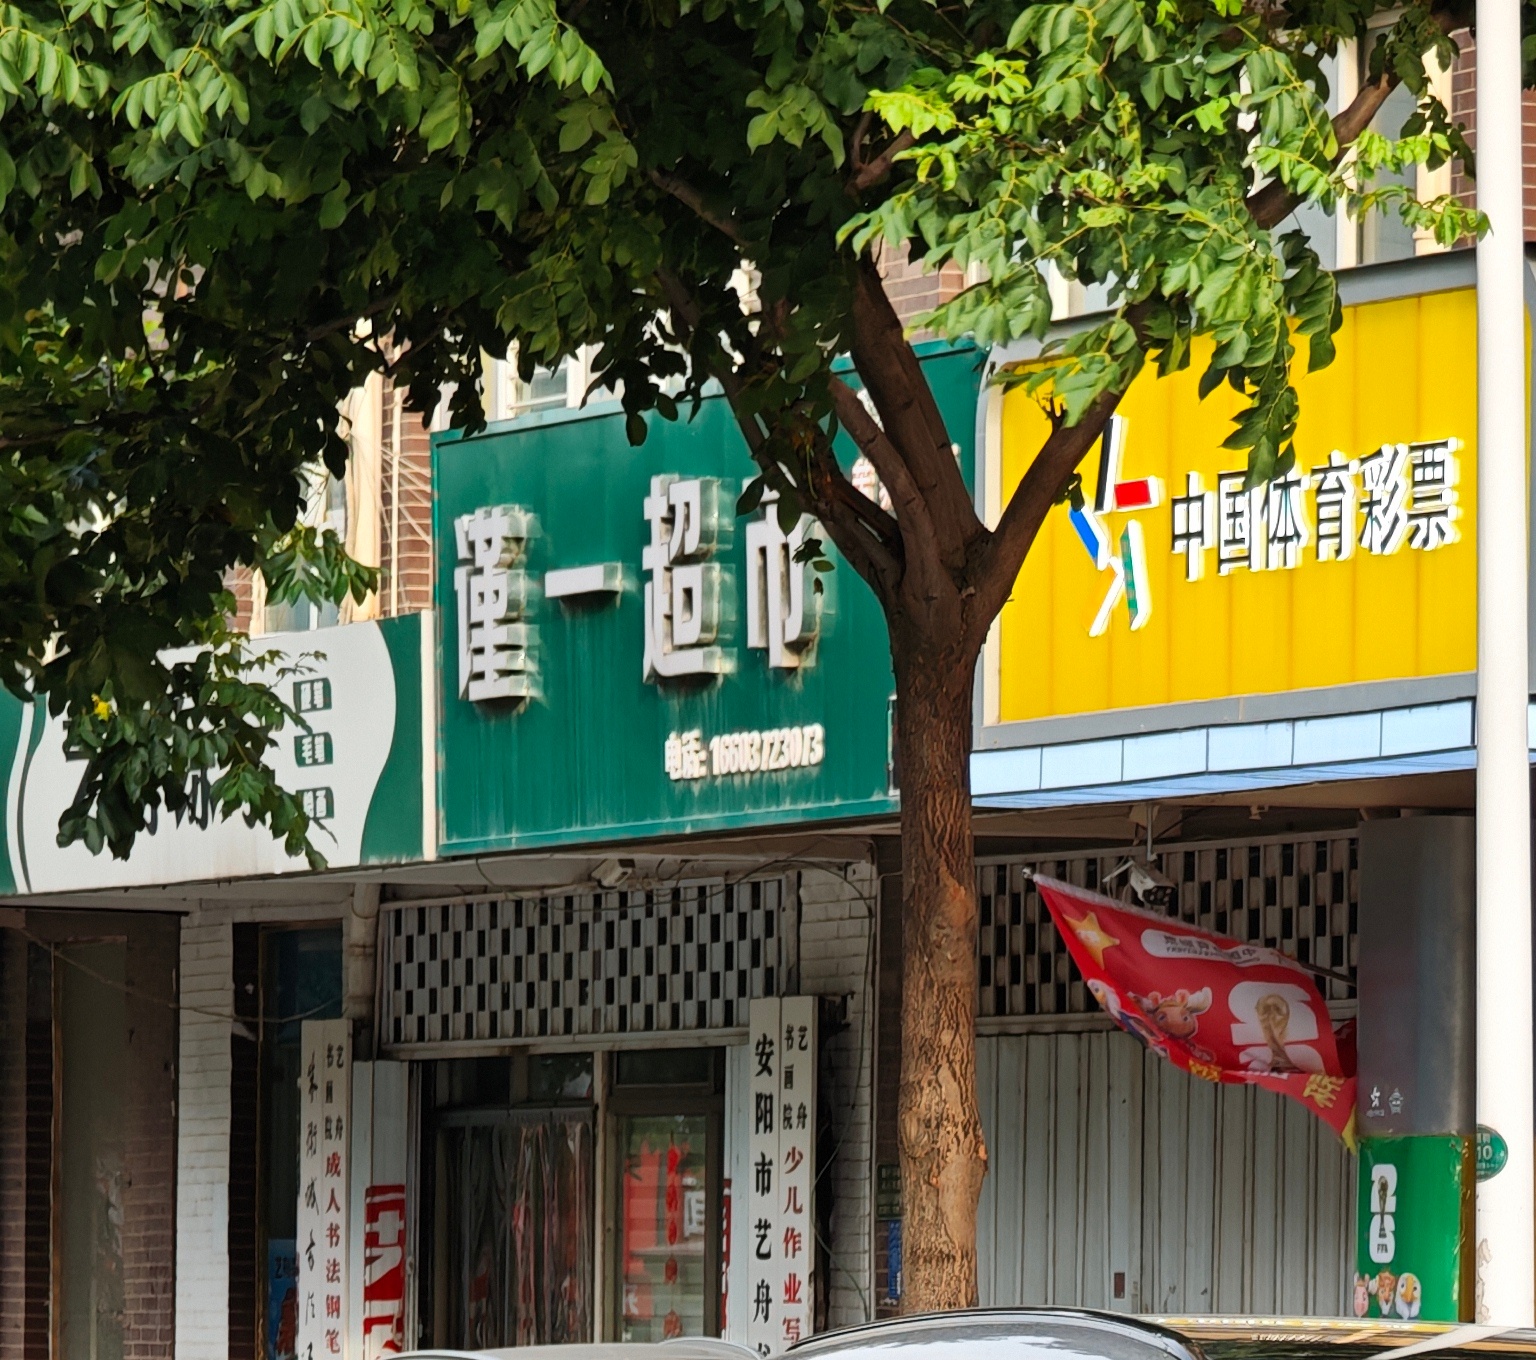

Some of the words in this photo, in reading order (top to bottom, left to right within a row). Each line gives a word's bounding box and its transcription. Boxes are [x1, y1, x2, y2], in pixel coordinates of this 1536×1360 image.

[1171, 437, 1463, 582] 中国体育彩票
